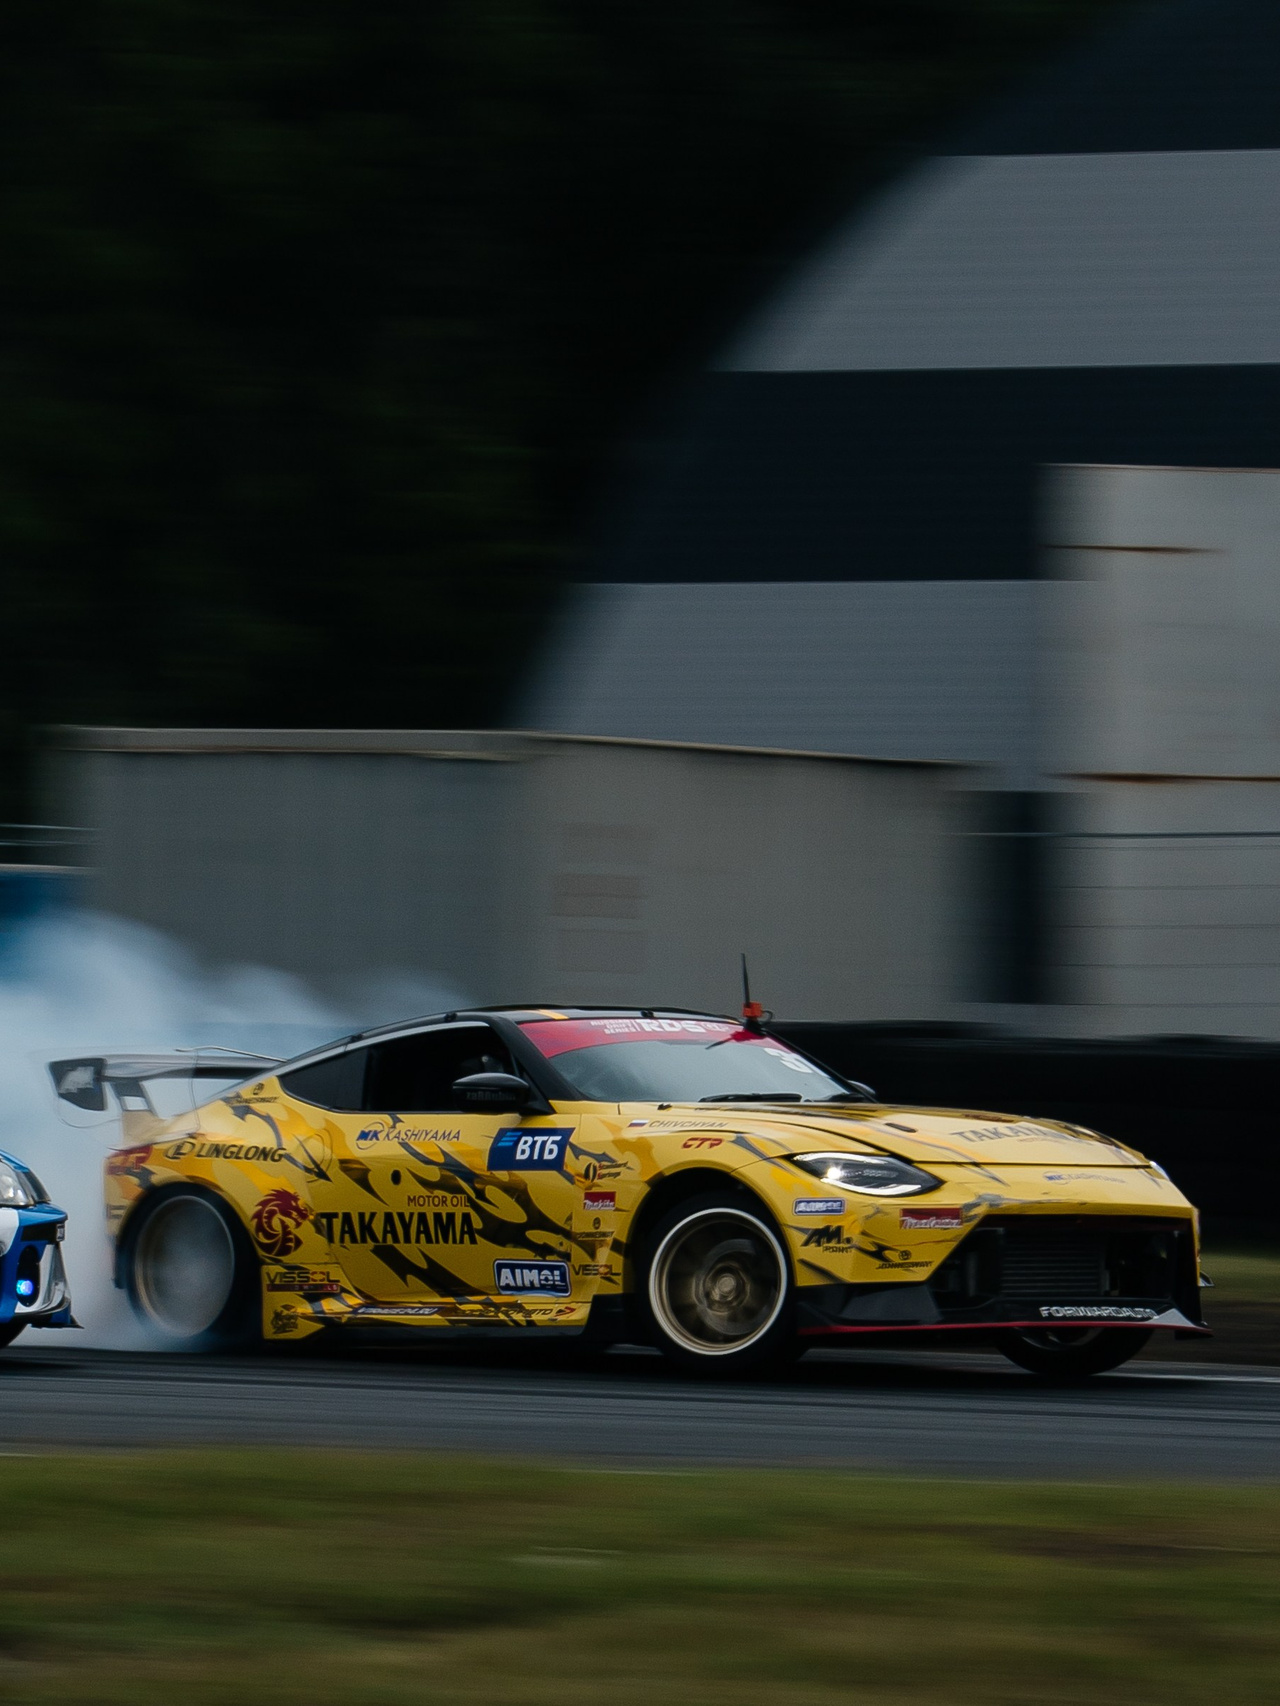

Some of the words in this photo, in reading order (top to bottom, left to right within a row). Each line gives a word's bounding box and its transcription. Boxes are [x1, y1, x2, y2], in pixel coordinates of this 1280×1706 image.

[635, 1018, 707, 1033] RDS
[356, 1129, 383, 1141] MK
[383, 1128, 461, 1141] KASHIYAMA
[196, 1142, 287, 1162] LINGLONG
[516, 1136, 562, 1160] ВТБ
[407, 1195, 448, 1207] MOTOR
[450, 1195, 470, 1207] OIL
[320, 1212, 478, 1244] TAKAYAMA
[266, 1271, 340, 1284] VISSOL
[500, 1268, 567, 1288] AIMOL
